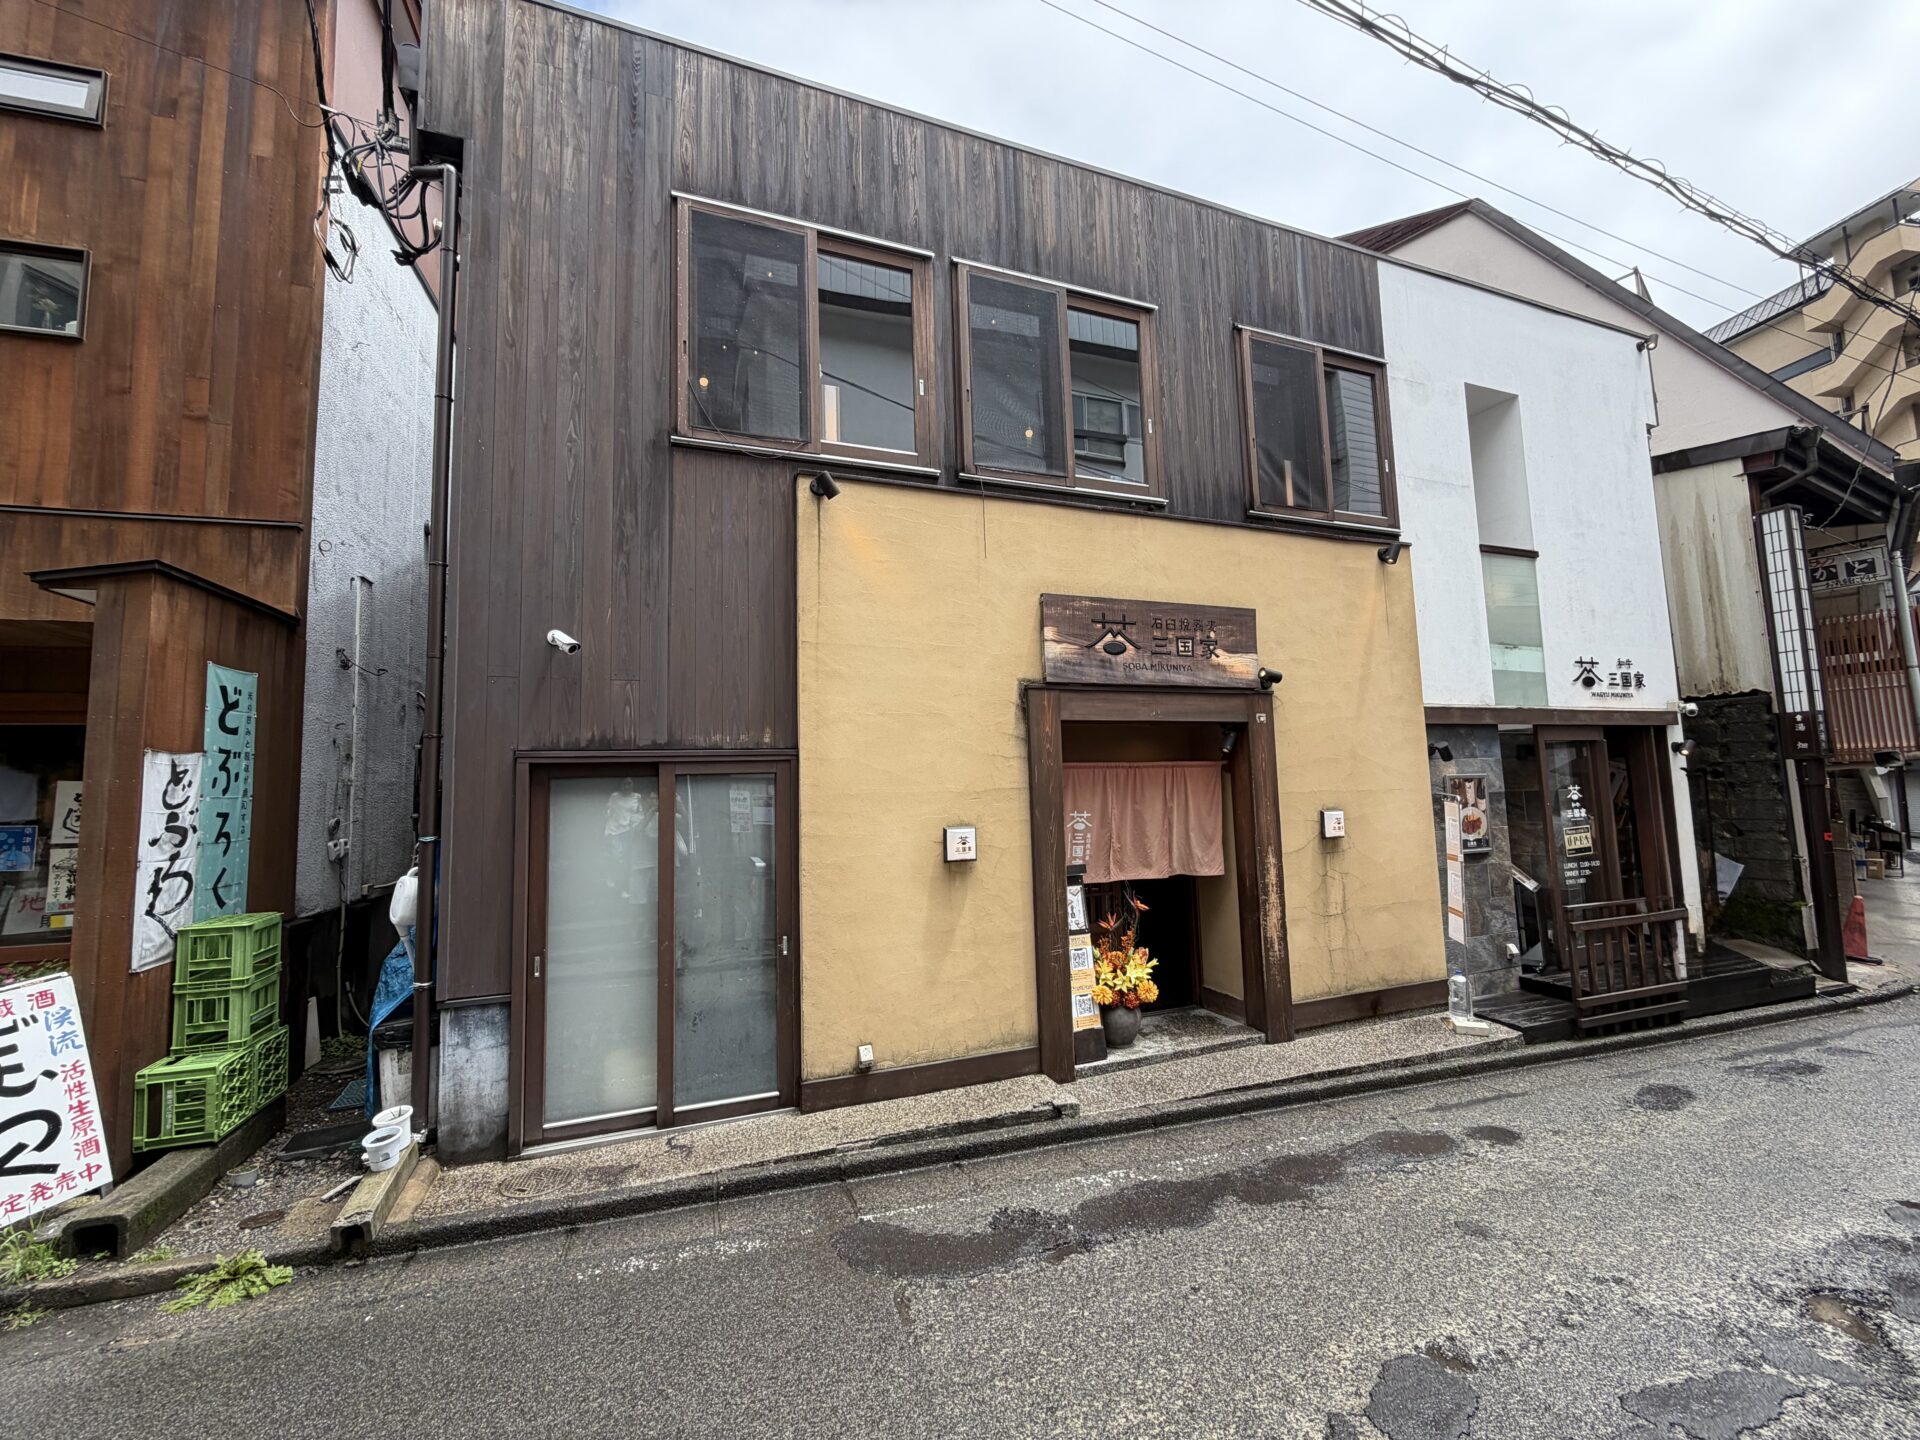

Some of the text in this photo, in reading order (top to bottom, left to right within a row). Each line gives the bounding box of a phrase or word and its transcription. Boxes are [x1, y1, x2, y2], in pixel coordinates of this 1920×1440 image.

[1150, 633, 1221, 660] 三国家
[1122, 662, 1193, 672] SOBA MIKUNIYA
[1608, 671, 1646, 688] 三国家
[211, 685, 242, 909] どぶろく
[1567, 834, 1590, 846] OPEN
[43, 1006, 85, 1057] 渓流
[60, 1059, 102, 1162] 活性生原酒
